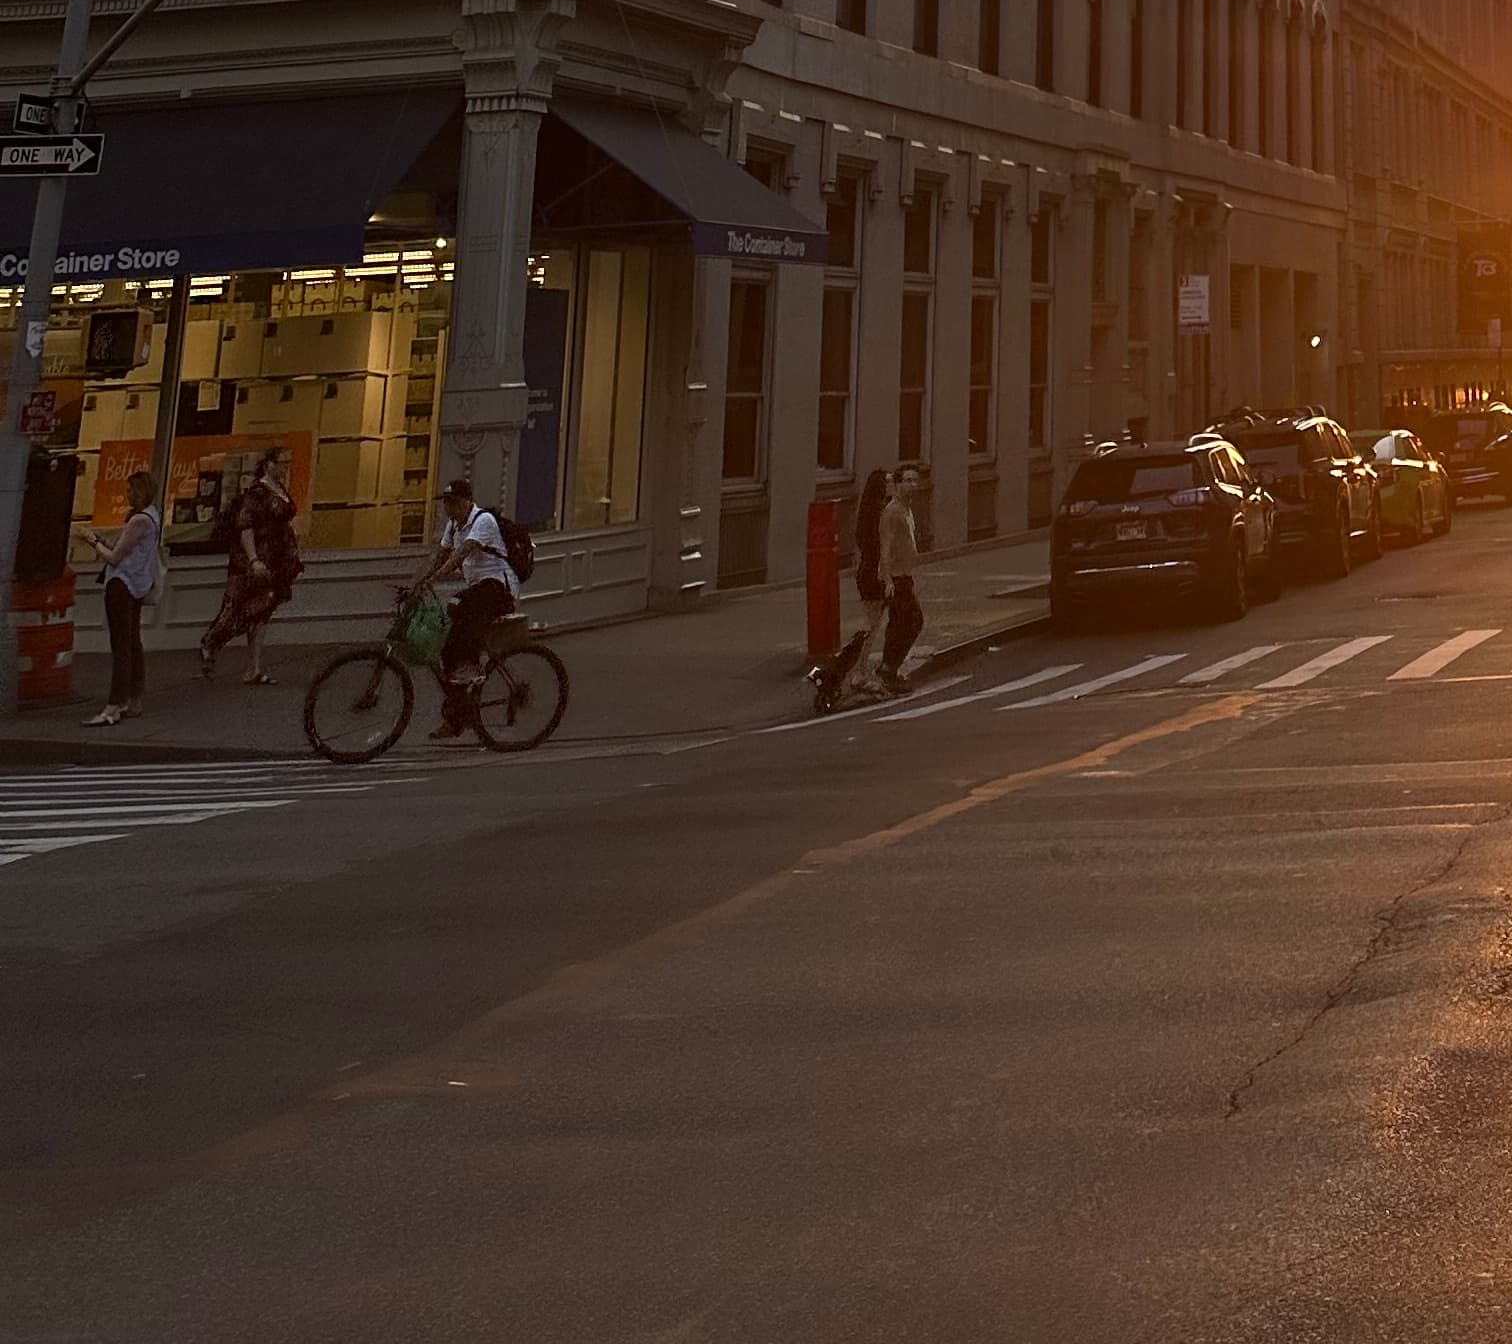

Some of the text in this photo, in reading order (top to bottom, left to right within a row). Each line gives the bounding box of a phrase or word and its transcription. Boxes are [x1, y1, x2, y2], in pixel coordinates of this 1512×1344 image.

[25, 106, 48, 124] ONE
[9, 147, 85, 163] ONE WAY
[0, 246, 182, 277] Coainer Store
